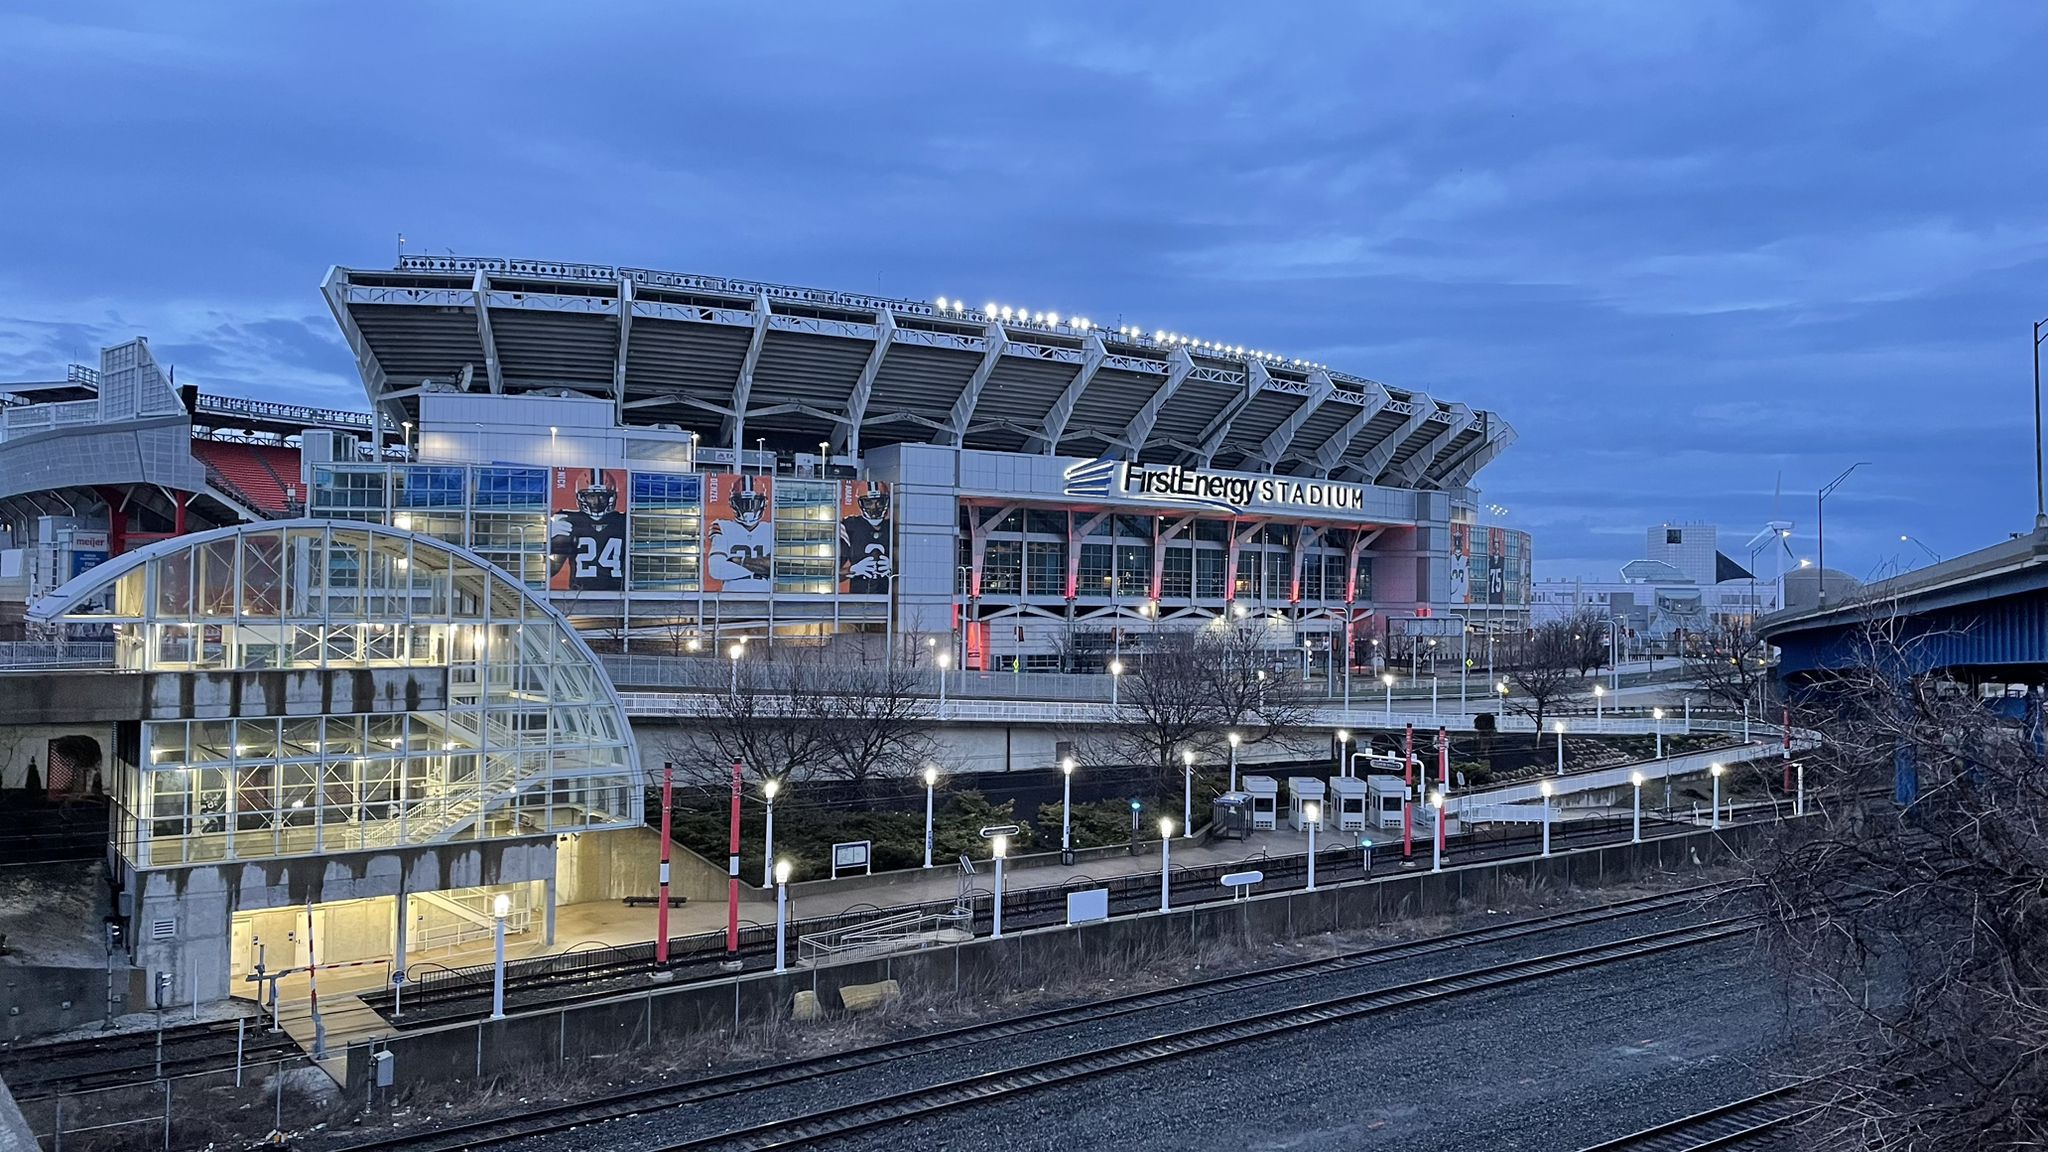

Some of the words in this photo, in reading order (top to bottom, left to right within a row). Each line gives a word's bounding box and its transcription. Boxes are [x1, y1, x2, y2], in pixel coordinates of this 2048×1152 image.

[557, 471, 567, 489] NICK
[710, 478, 719, 503] DENZEL
[1123, 462, 1257, 506] FirstEnergy
[1261, 480, 1363, 509] STADIUM
[845, 485, 853, 506] AMARI
[76, 538, 104, 548] meijer
[576, 537, 623, 577] 24
[1490, 568, 1502, 593] 75
